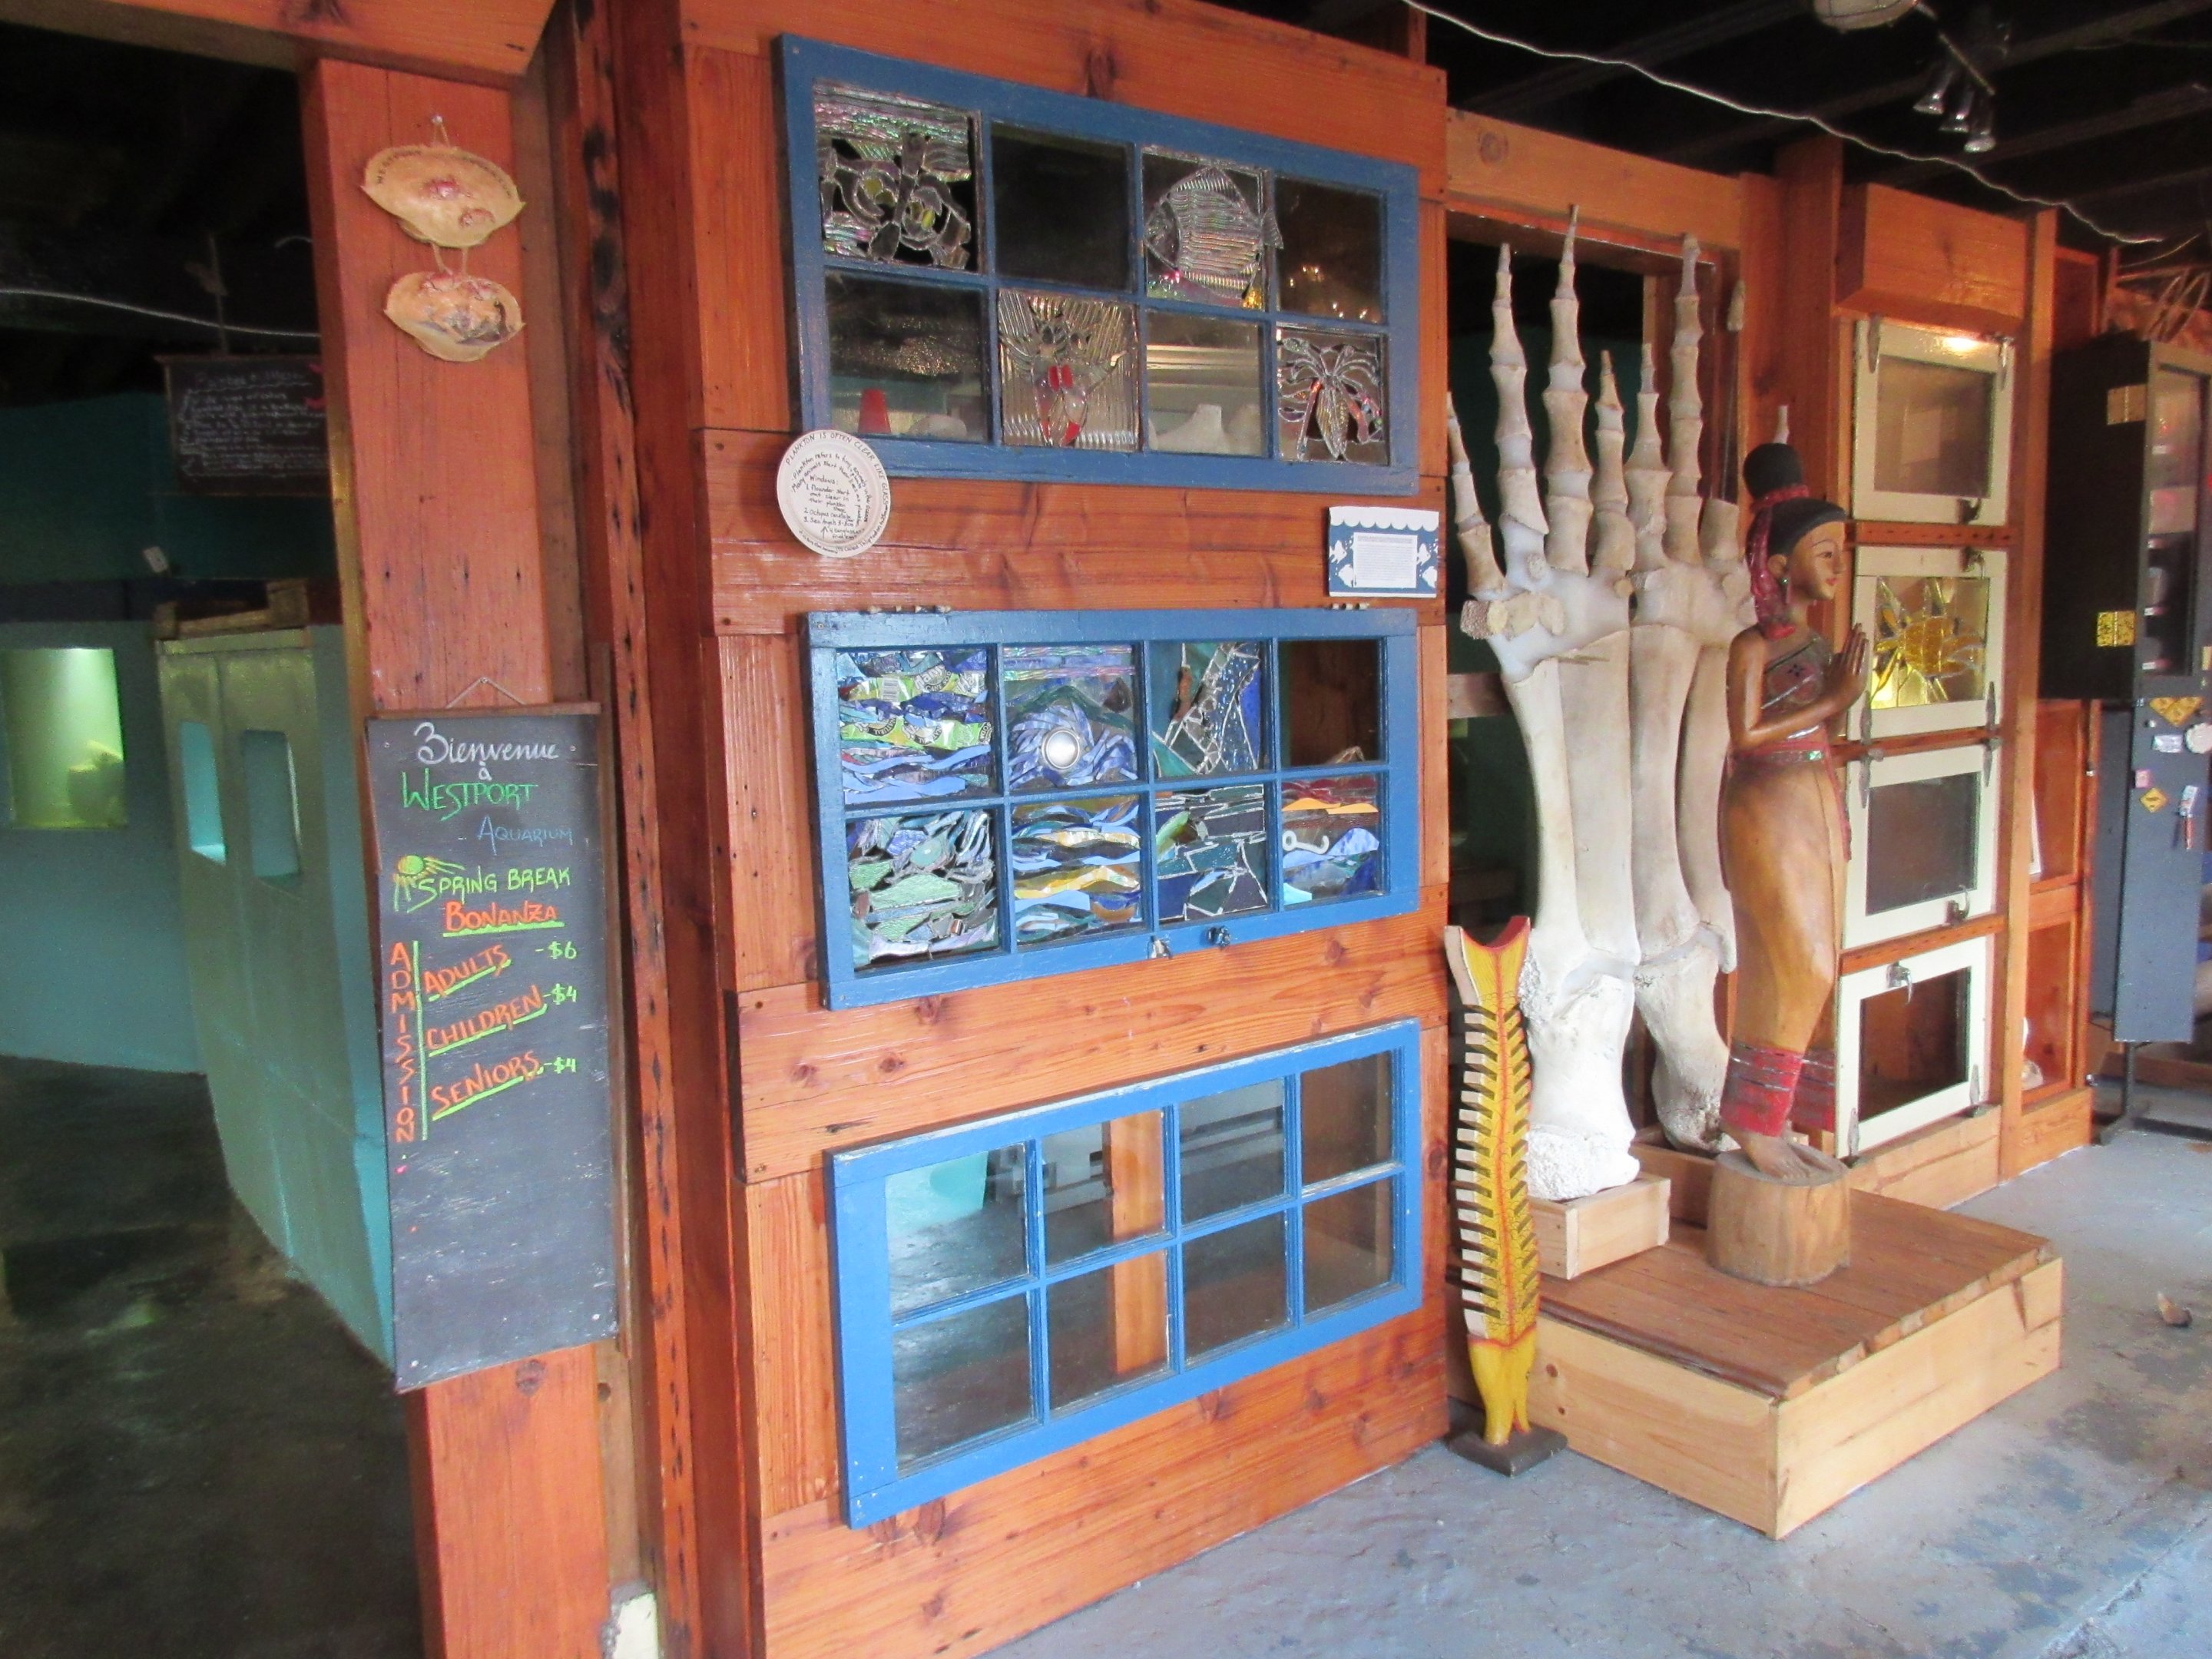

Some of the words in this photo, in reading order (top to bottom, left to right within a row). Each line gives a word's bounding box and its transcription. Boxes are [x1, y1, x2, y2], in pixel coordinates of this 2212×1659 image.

[786, 434, 815, 466] PLANKTON
[830, 432, 852, 444] OFTEN
[854, 442, 876, 462] CLEAR
[874, 463, 883, 478] LIKE
[881, 483, 889, 505] GLASS
[792, 477, 806, 492] Many
[413, 721, 560, 765] Bienvenue
[401, 767, 538, 822] WESTPORT
[476, 814, 573, 856] AQUARIUM
[406, 865, 498, 913] SPRING
[507, 866, 571, 894] BREAK
[443, 899, 559, 932] BONANZA
[423, 944, 510, 998] ADULTS
[389, 941, 417, 1144] ADMISSION
[426, 984, 545, 1050] CHILDREN
[430, 1050, 540, 1117] SENIORS
